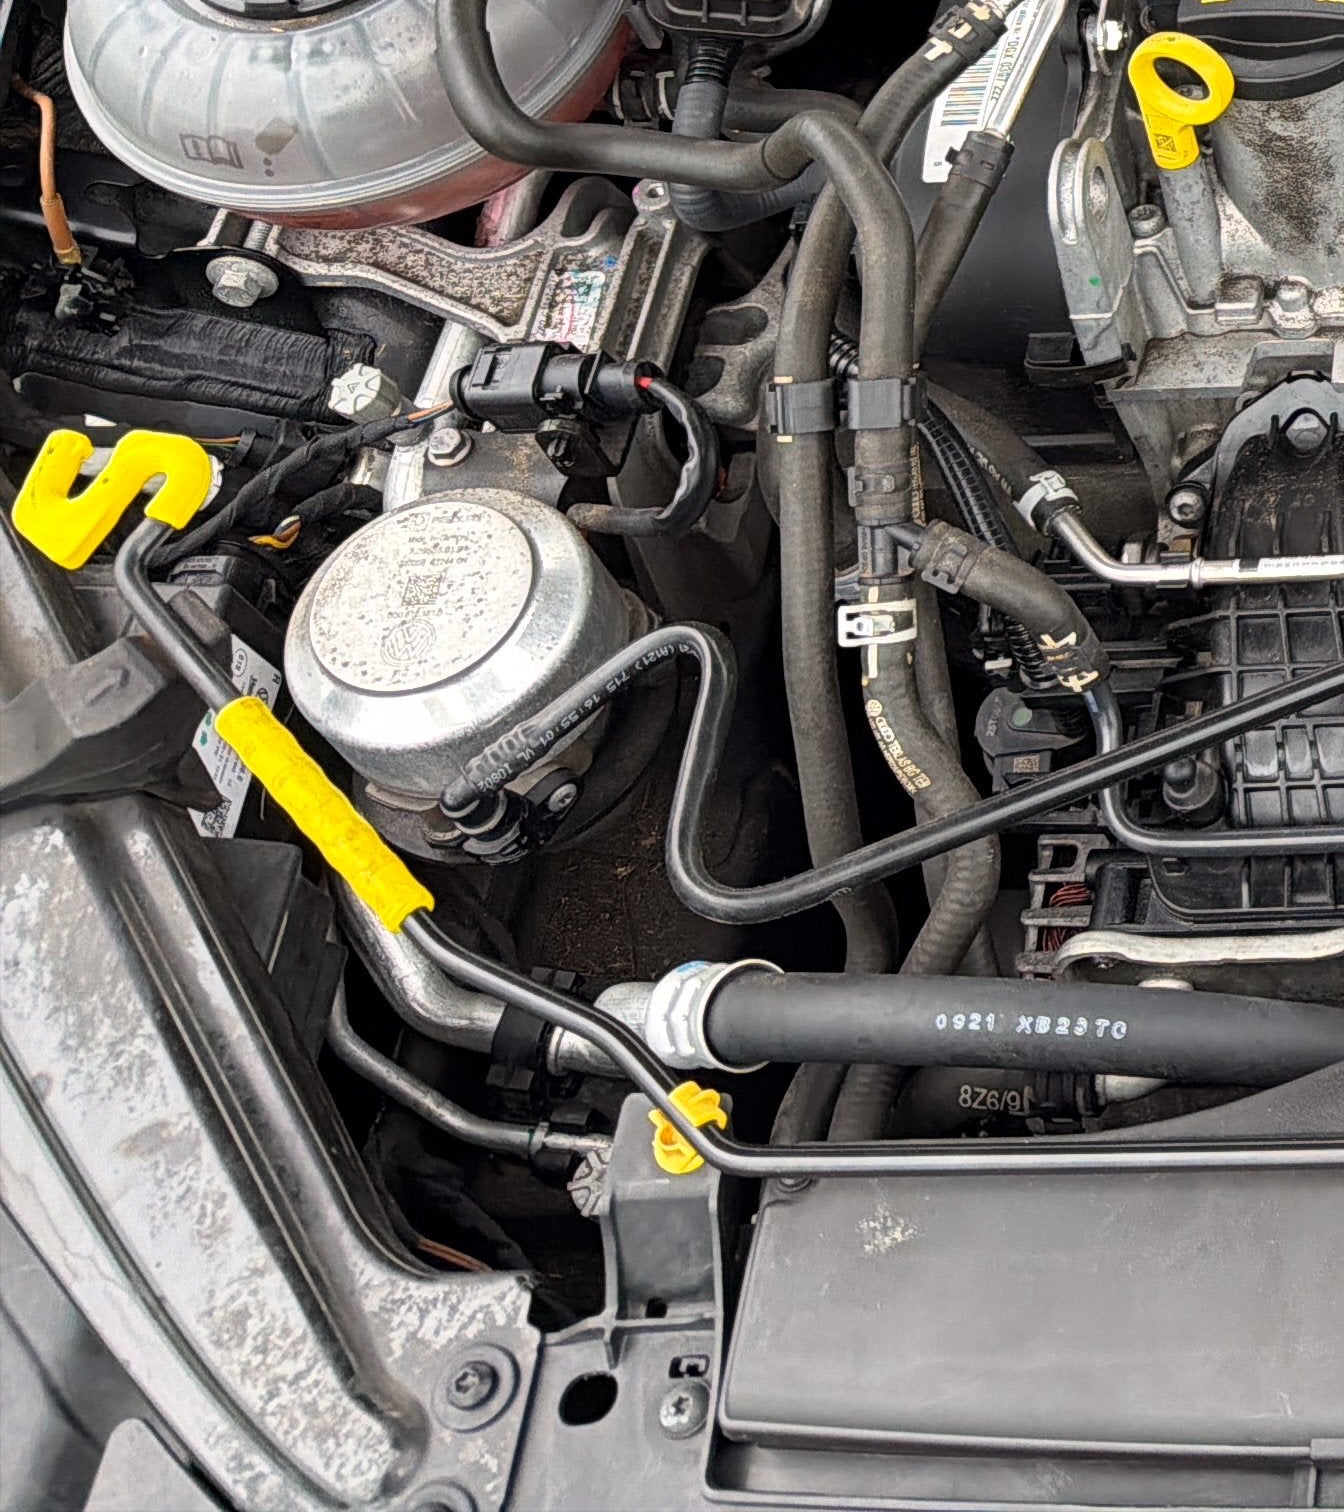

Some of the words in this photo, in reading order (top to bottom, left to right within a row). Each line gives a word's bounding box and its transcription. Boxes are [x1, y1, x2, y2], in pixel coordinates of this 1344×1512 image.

[517, 748, 536, 762] VL
[936, 1012, 996, 1032] 0921
[958, 1085, 1021, 1111] 8Z6/9
